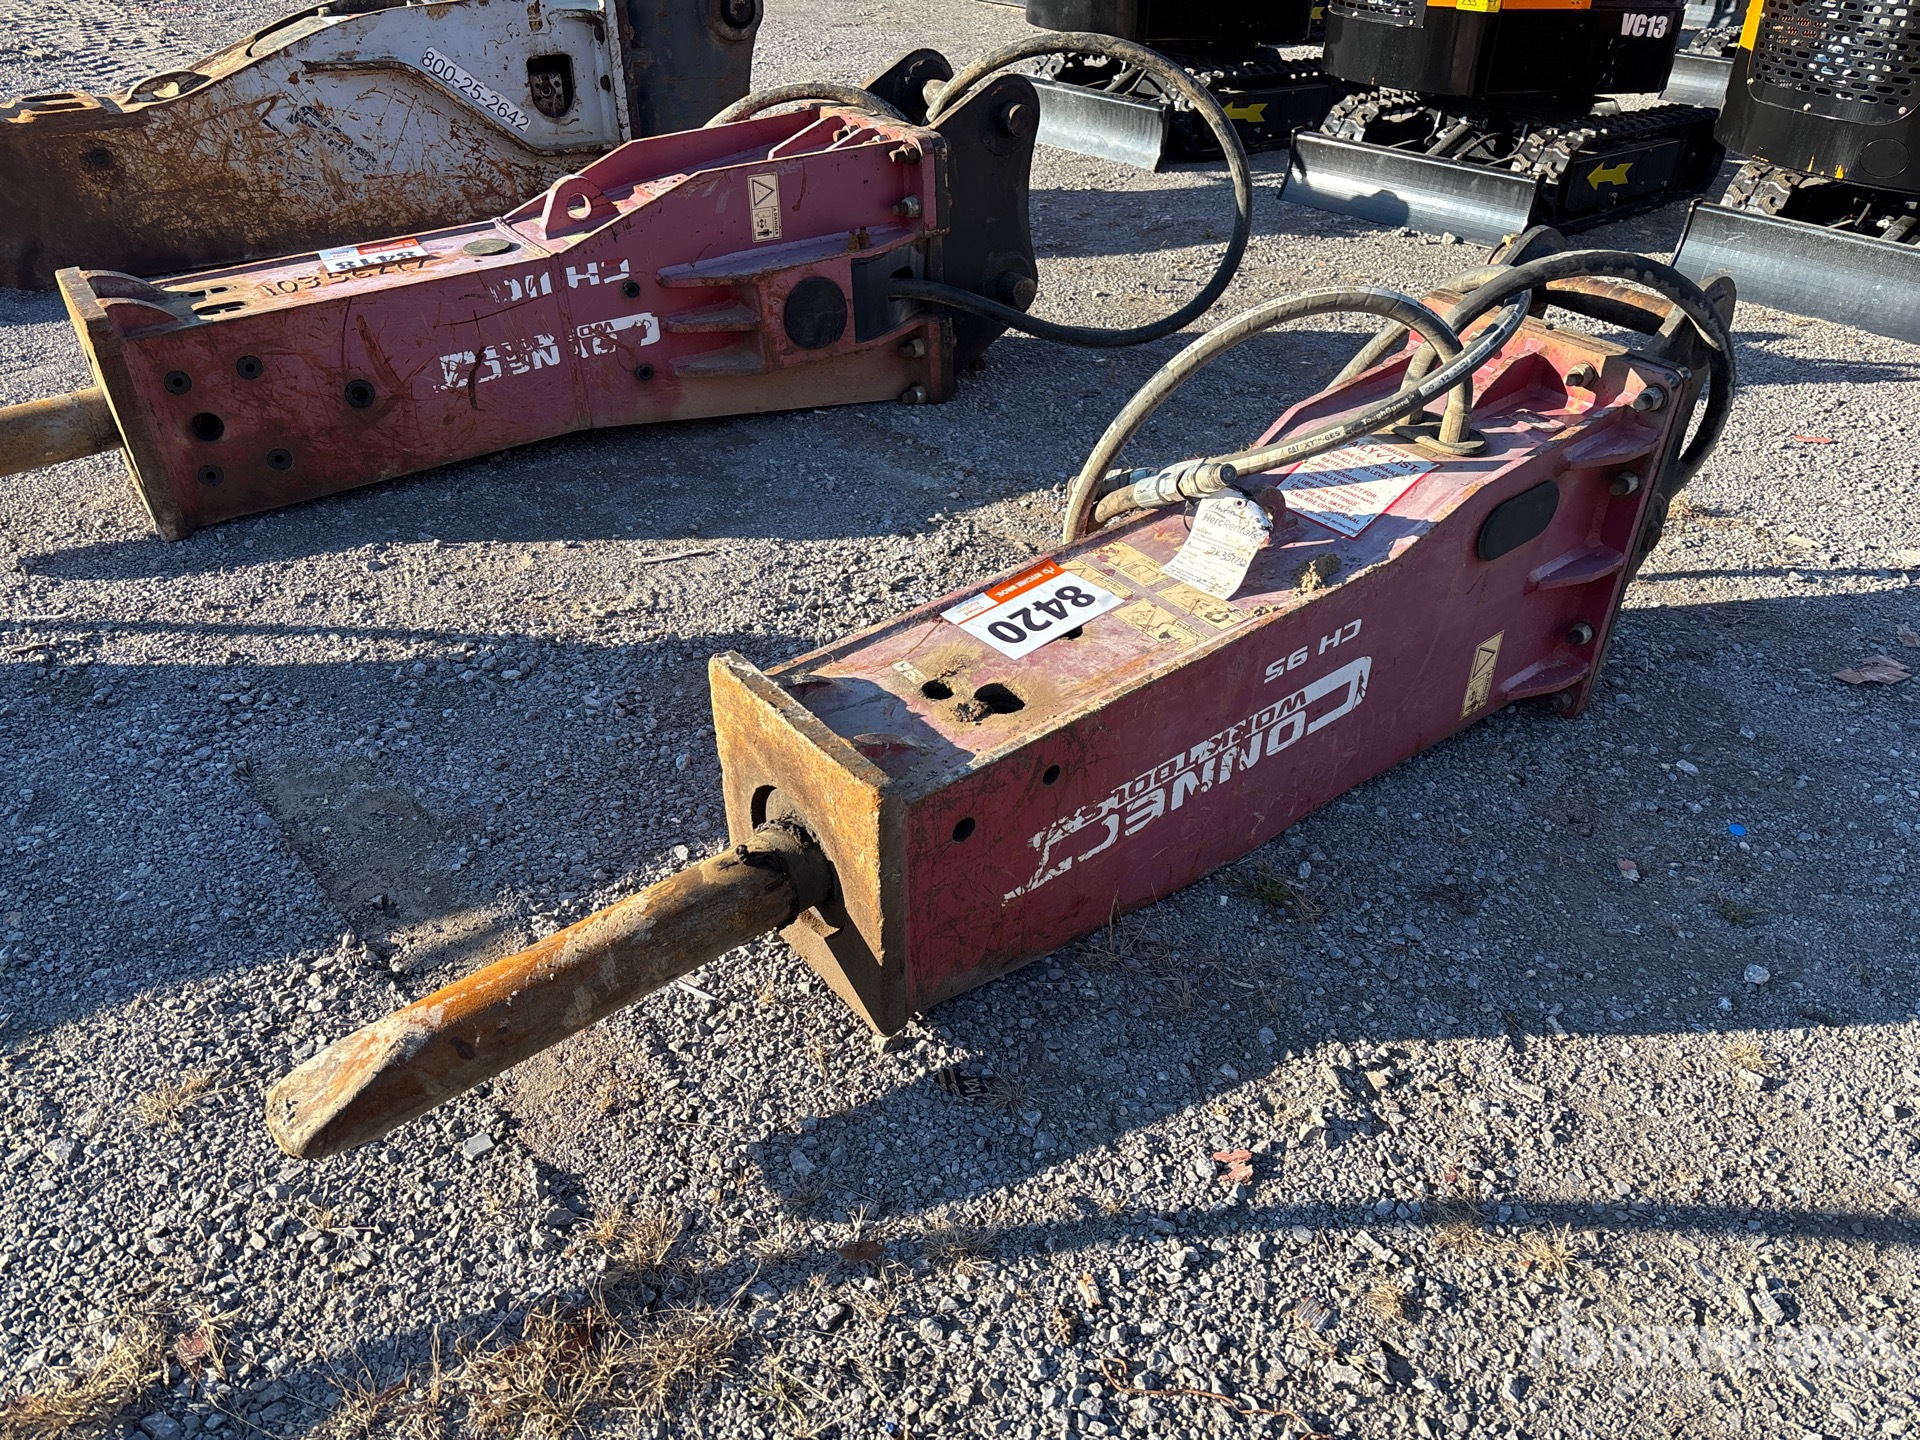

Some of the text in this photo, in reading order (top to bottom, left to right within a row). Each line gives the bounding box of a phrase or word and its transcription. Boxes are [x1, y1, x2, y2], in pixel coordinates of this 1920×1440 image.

[1620, 13, 1669, 39] VC13
[421, 50, 530, 132] 800-25-2642
[335, 250, 417, 271] 8418
[1347, 440, 1379, 455] AILY
[1304, 496, 1318, 506] ARE
[1314, 493, 1328, 504] ALL
[1327, 499, 1353, 514] SAFETY
[1202, 512, 1260, 540] HercRentals
[1017, 572, 1043, 588] RITCHIE
[963, 605, 986, 617] Timed
[987, 585, 1096, 644] 8420
[1262, 618, 1363, 685] CH 95
